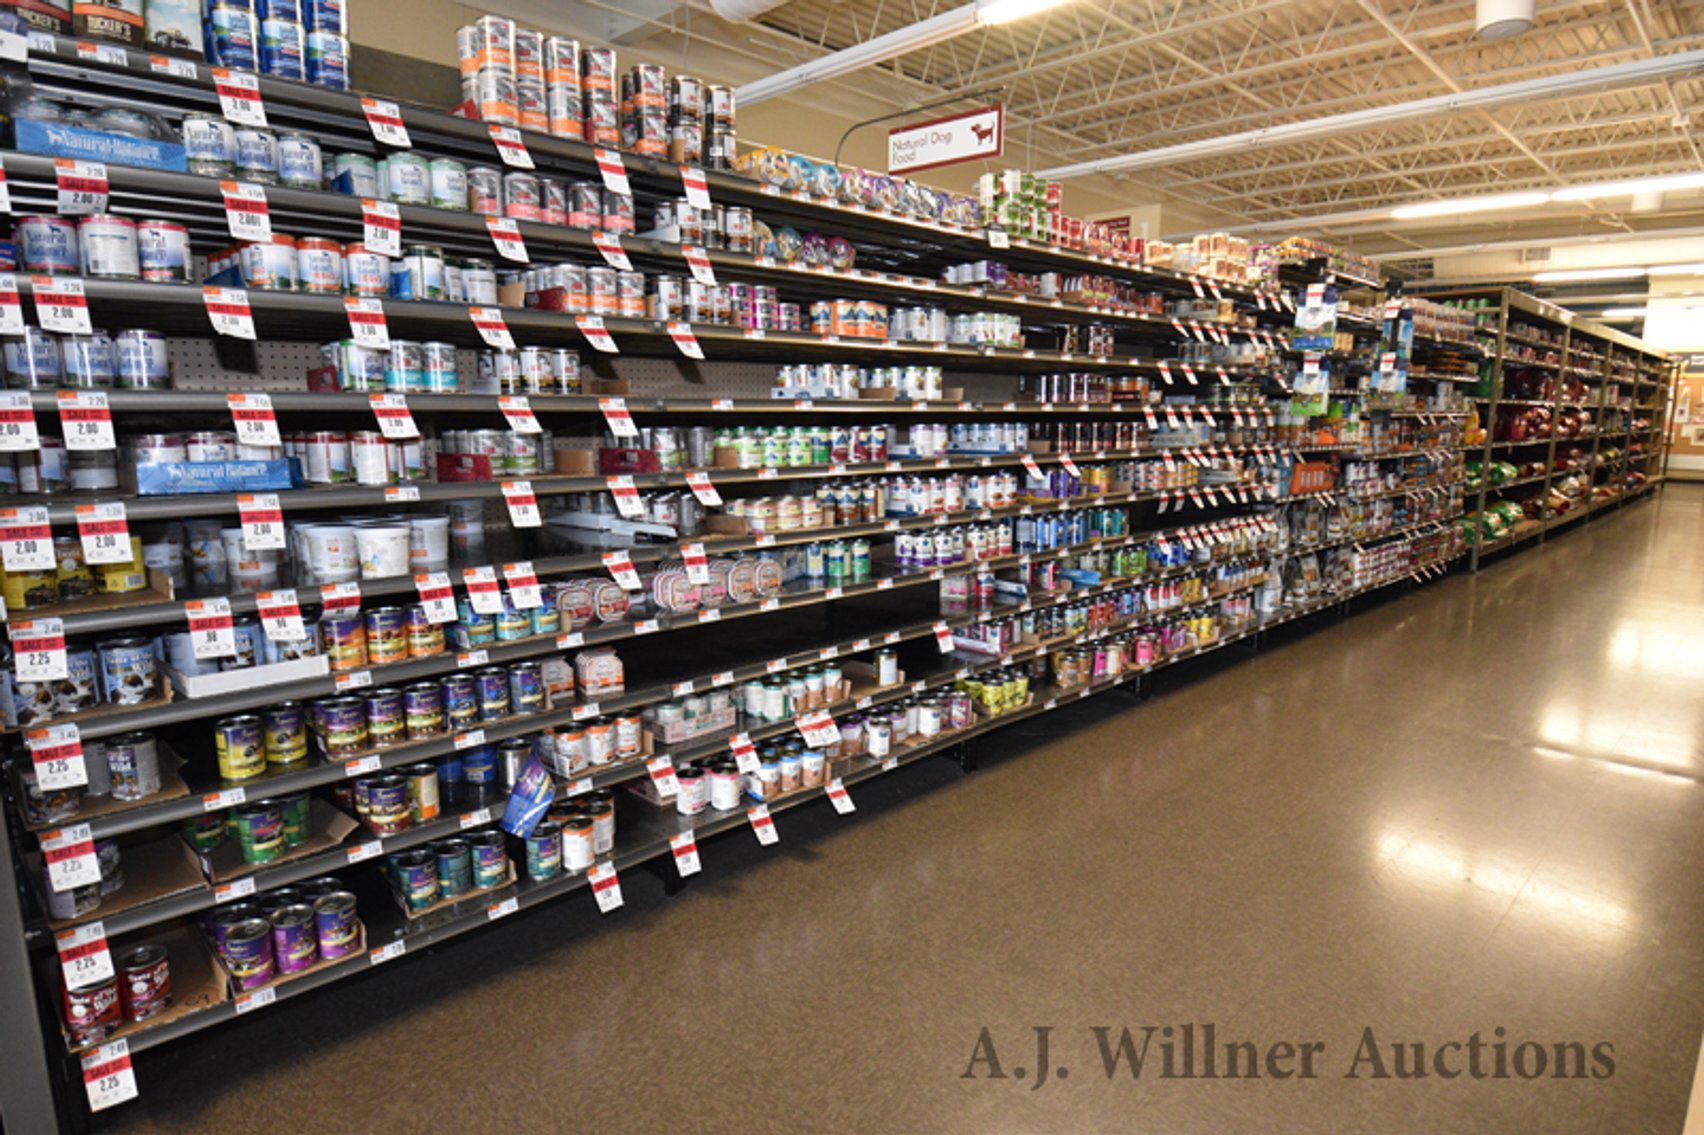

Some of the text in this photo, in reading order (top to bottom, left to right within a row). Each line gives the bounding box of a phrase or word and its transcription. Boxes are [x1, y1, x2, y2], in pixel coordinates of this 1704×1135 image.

[61, 128, 110, 152] Natural
[892, 131, 953, 152] Natural Dog
[892, 151, 917, 165] Food
[66, 410, 88, 420] SALE
[77, 423, 98, 436] 2.00
[15, 541, 37, 555] 2.00
[95, 535, 116, 549] 2.00
[20, 640, 42, 652] SALE
[28, 652, 51, 666] 2.25
[47, 760, 69, 774] 2.25
[75, 958, 97, 972] 2.25
[99, 1076, 120, 1092] 2.25
